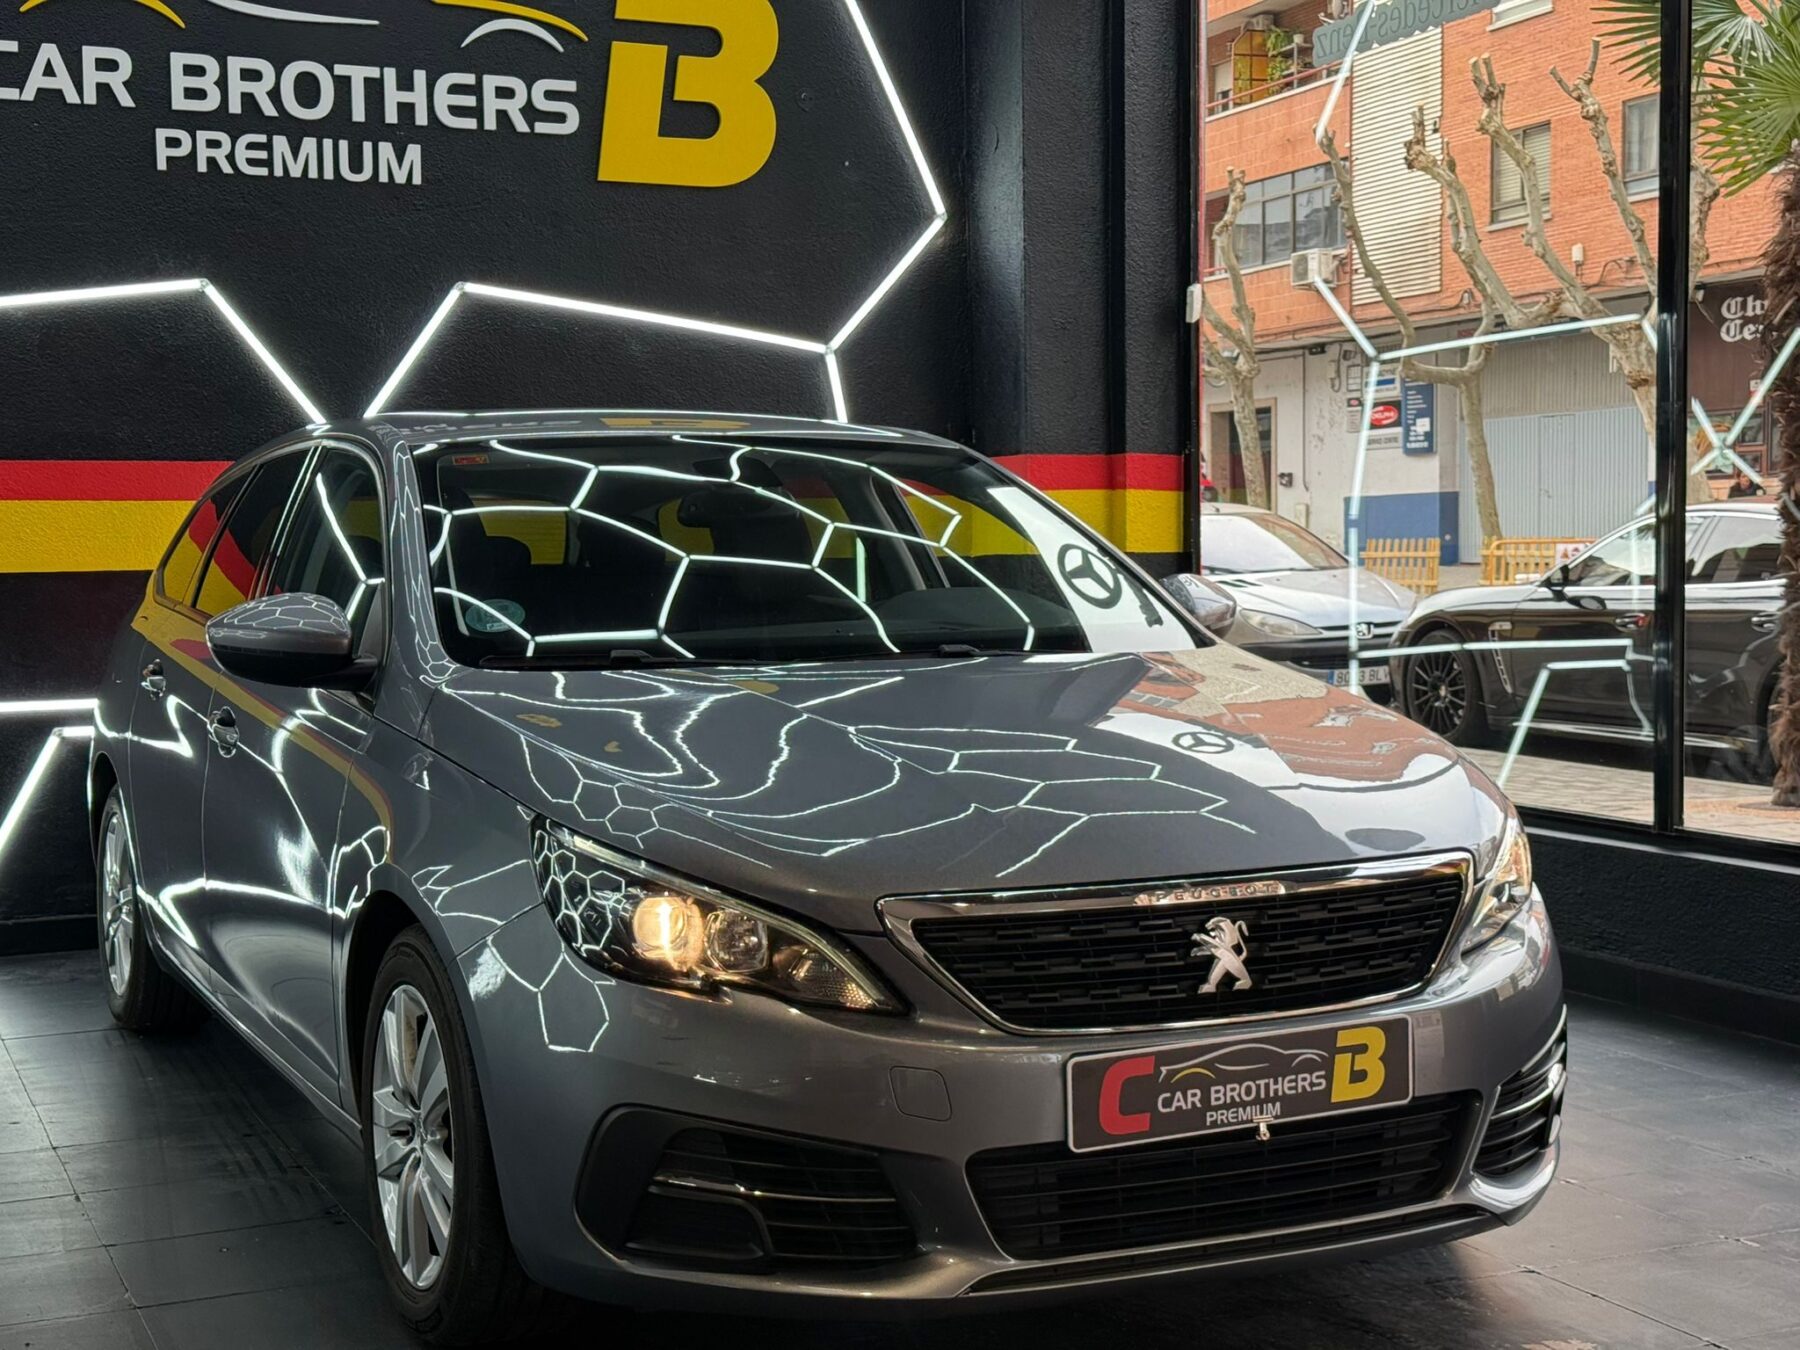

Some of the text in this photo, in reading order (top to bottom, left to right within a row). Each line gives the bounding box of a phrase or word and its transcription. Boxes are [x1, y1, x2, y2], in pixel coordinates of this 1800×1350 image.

[170, 52, 580, 135] BROTHERS
[597, 0, 780, 188] B
[155, 128, 423, 186] PREMIUM
[1720, 295, 1768, 319] Ch
[1336, 670, 1366, 684] 803
[1154, 881, 1280, 902] PEUGEOT
[1331, 1026, 1386, 1103] B
[1099, 1055, 1155, 1136] C
[1157, 1070, 1327, 1113] CAR BROTHERS
[1206, 1101, 1281, 1126] PREMIUM
